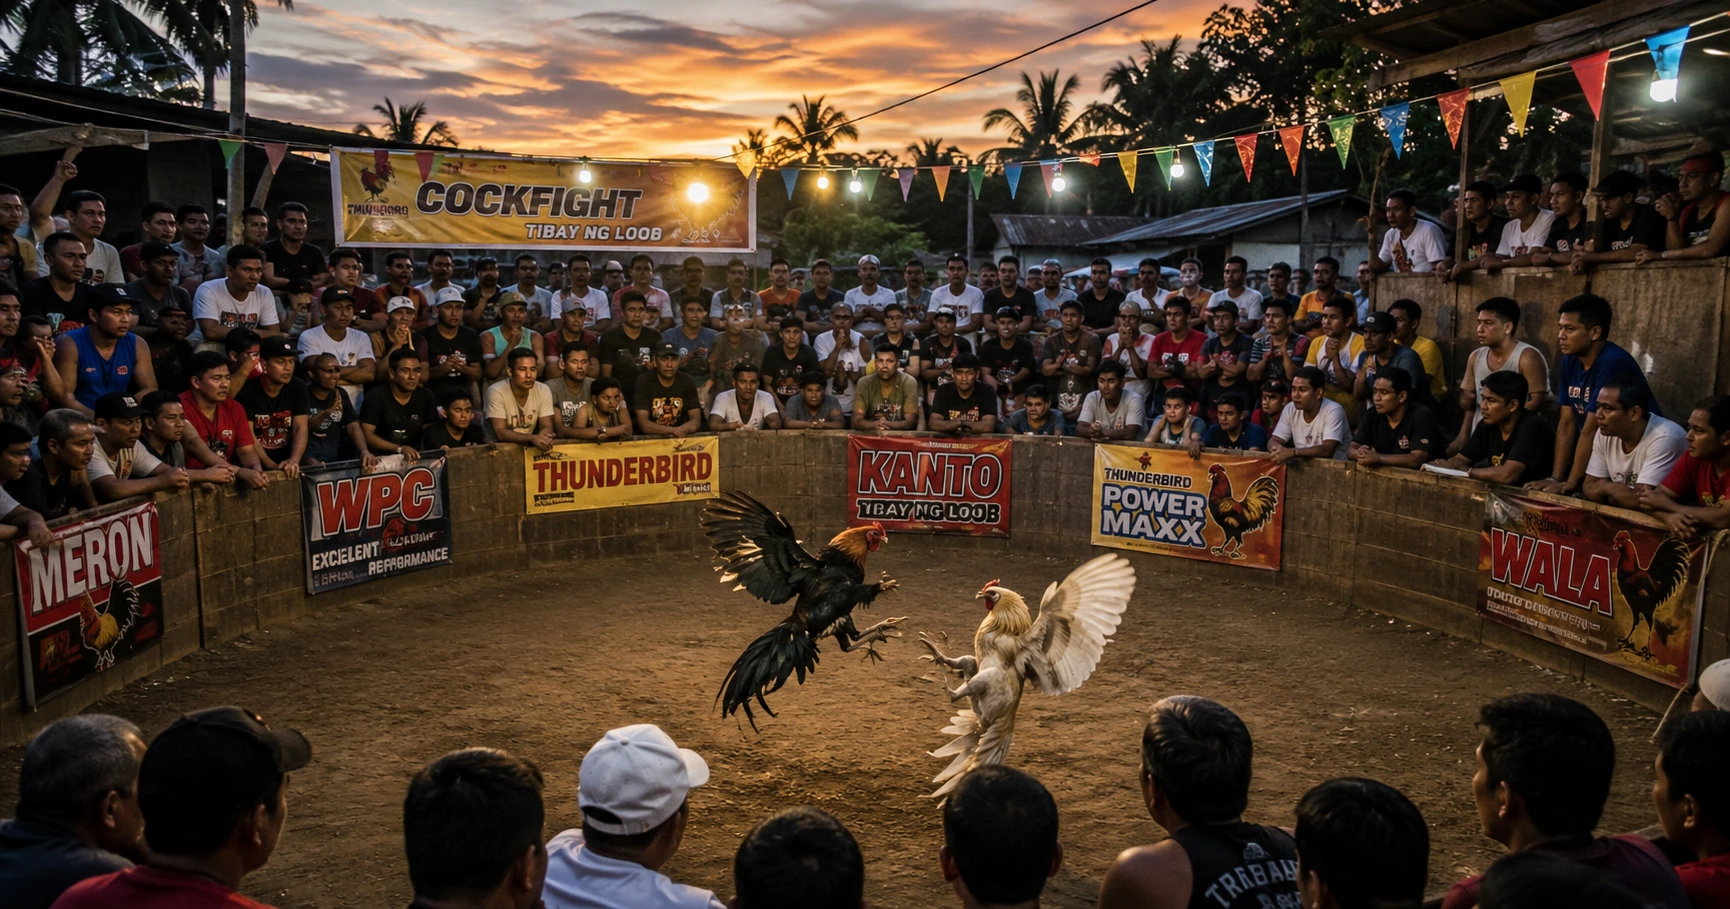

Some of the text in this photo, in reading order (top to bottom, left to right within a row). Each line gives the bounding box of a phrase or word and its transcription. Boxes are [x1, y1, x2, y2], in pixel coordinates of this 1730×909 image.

[415, 180, 643, 219] COCKFIGHT
[525, 223, 662, 242] TIBAY NG LOOB
[533, 452, 713, 493] THUNDERBIRD
[858, 450, 1002, 499] KANTO
[1104, 467, 1193, 489] THUNDERBIRD
[317, 467, 435, 537] WPC
[914, 500, 944, 523] NG
[945, 501, 1001, 524] LOOB
[1104, 485, 1205, 518] POWER
[1103, 510, 1205, 545] MAXX
[29, 511, 153, 615] MERON
[1491, 527, 1613, 617] WALA
